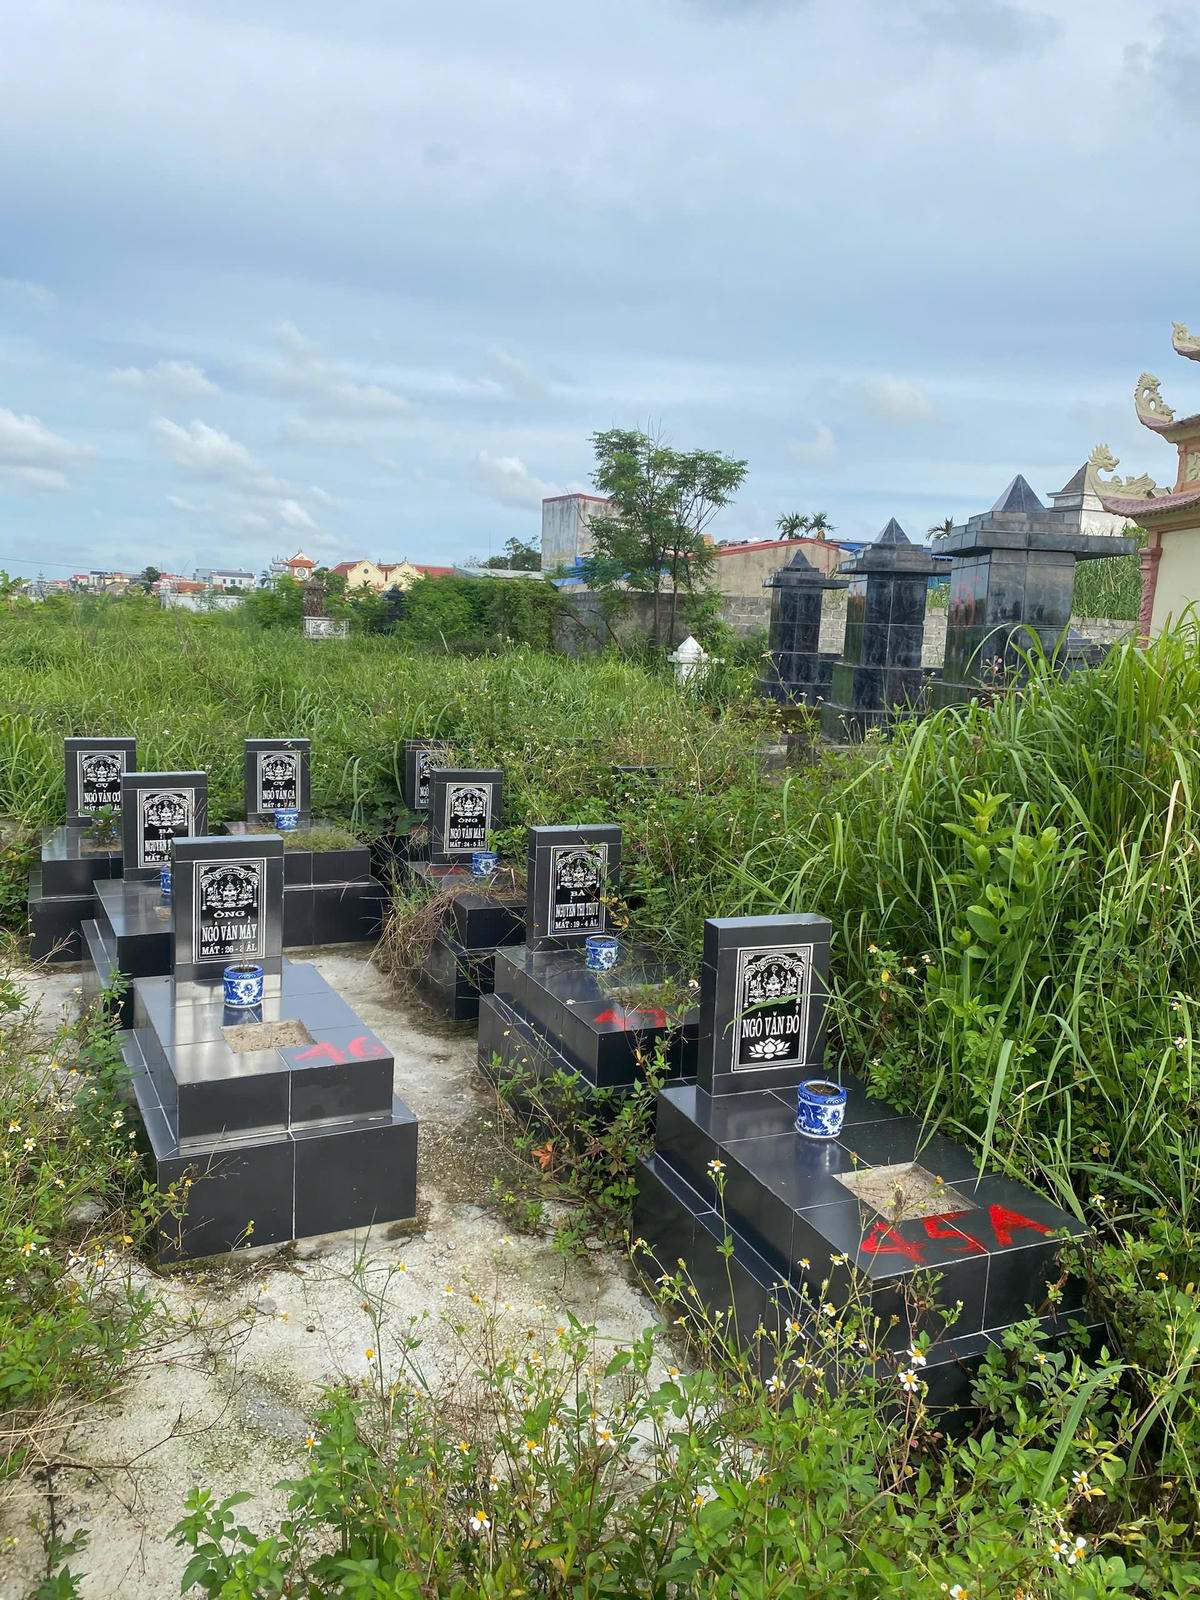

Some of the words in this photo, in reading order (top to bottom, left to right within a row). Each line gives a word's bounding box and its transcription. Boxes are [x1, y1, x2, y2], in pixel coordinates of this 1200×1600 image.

[84, 789, 98, 803] NGÔ
[98, 789, 112, 803] VĂN
[449, 825, 462, 839] NGÔ
[461, 825, 474, 839] VĂN
[213, 910, 246, 919] ÔNG
[201, 921, 220, 943] NGÔ
[220, 921, 239, 941] VĂN
[741, 1011, 763, 1038] NGÔ
[764, 1010, 786, 1036] VĂN
